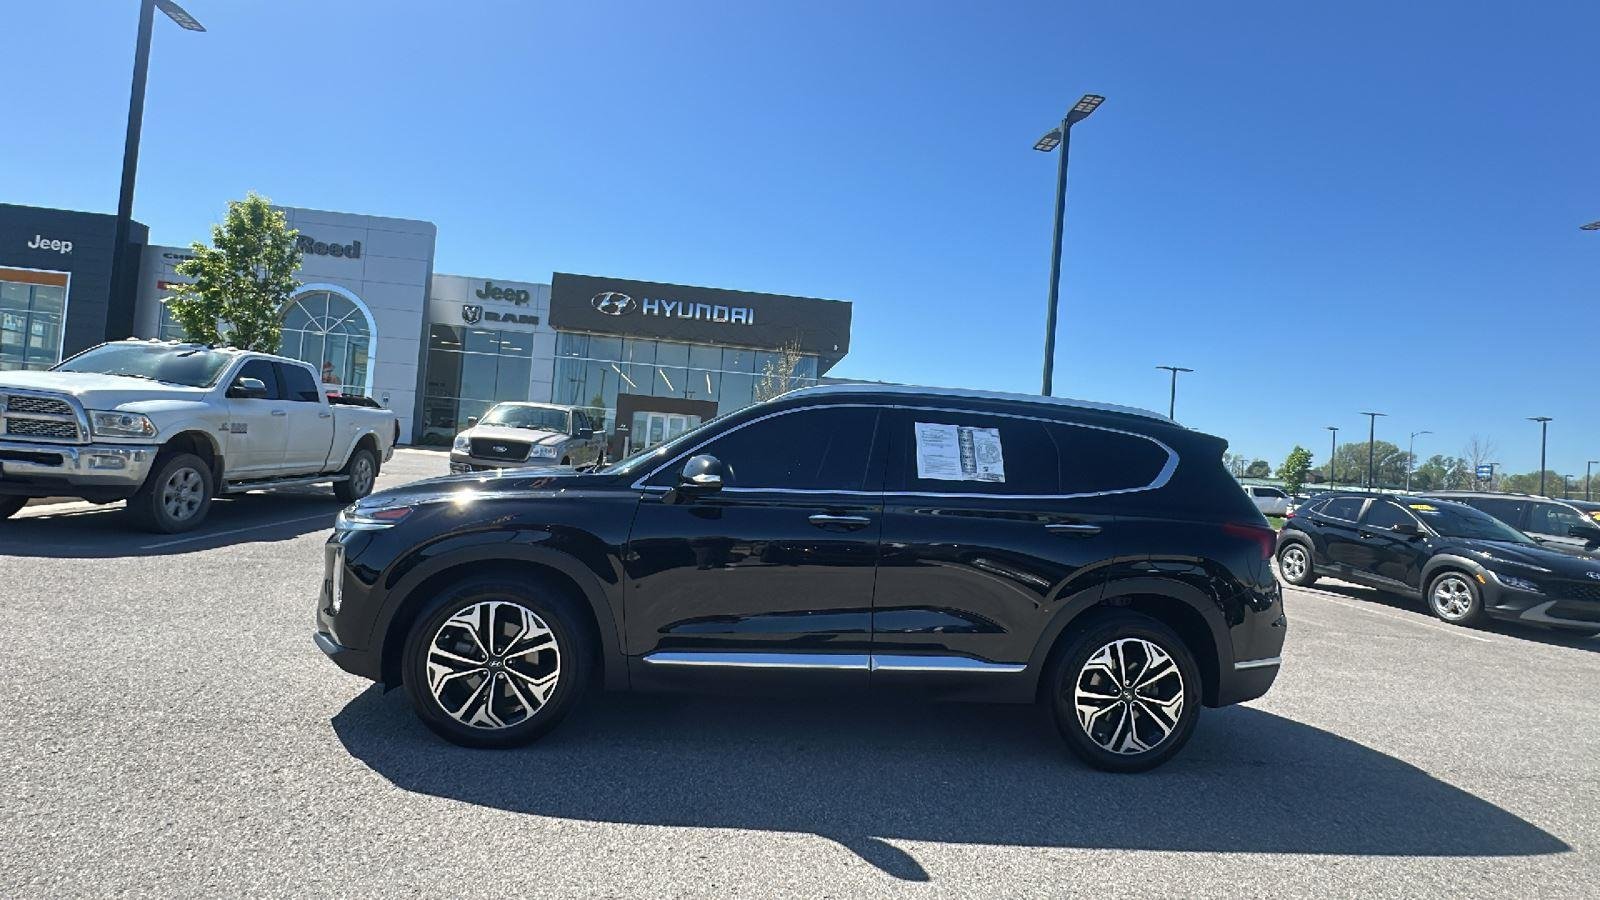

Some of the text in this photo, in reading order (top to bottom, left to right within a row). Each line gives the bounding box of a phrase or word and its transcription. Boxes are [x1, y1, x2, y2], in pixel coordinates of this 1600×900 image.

[28, 234, 73, 254] Jeep
[296, 234, 361, 259] Reed
[476, 281, 530, 305] Jeep
[484, 311, 539, 326] RAM
[642, 298, 754, 325] HYUNDAI
